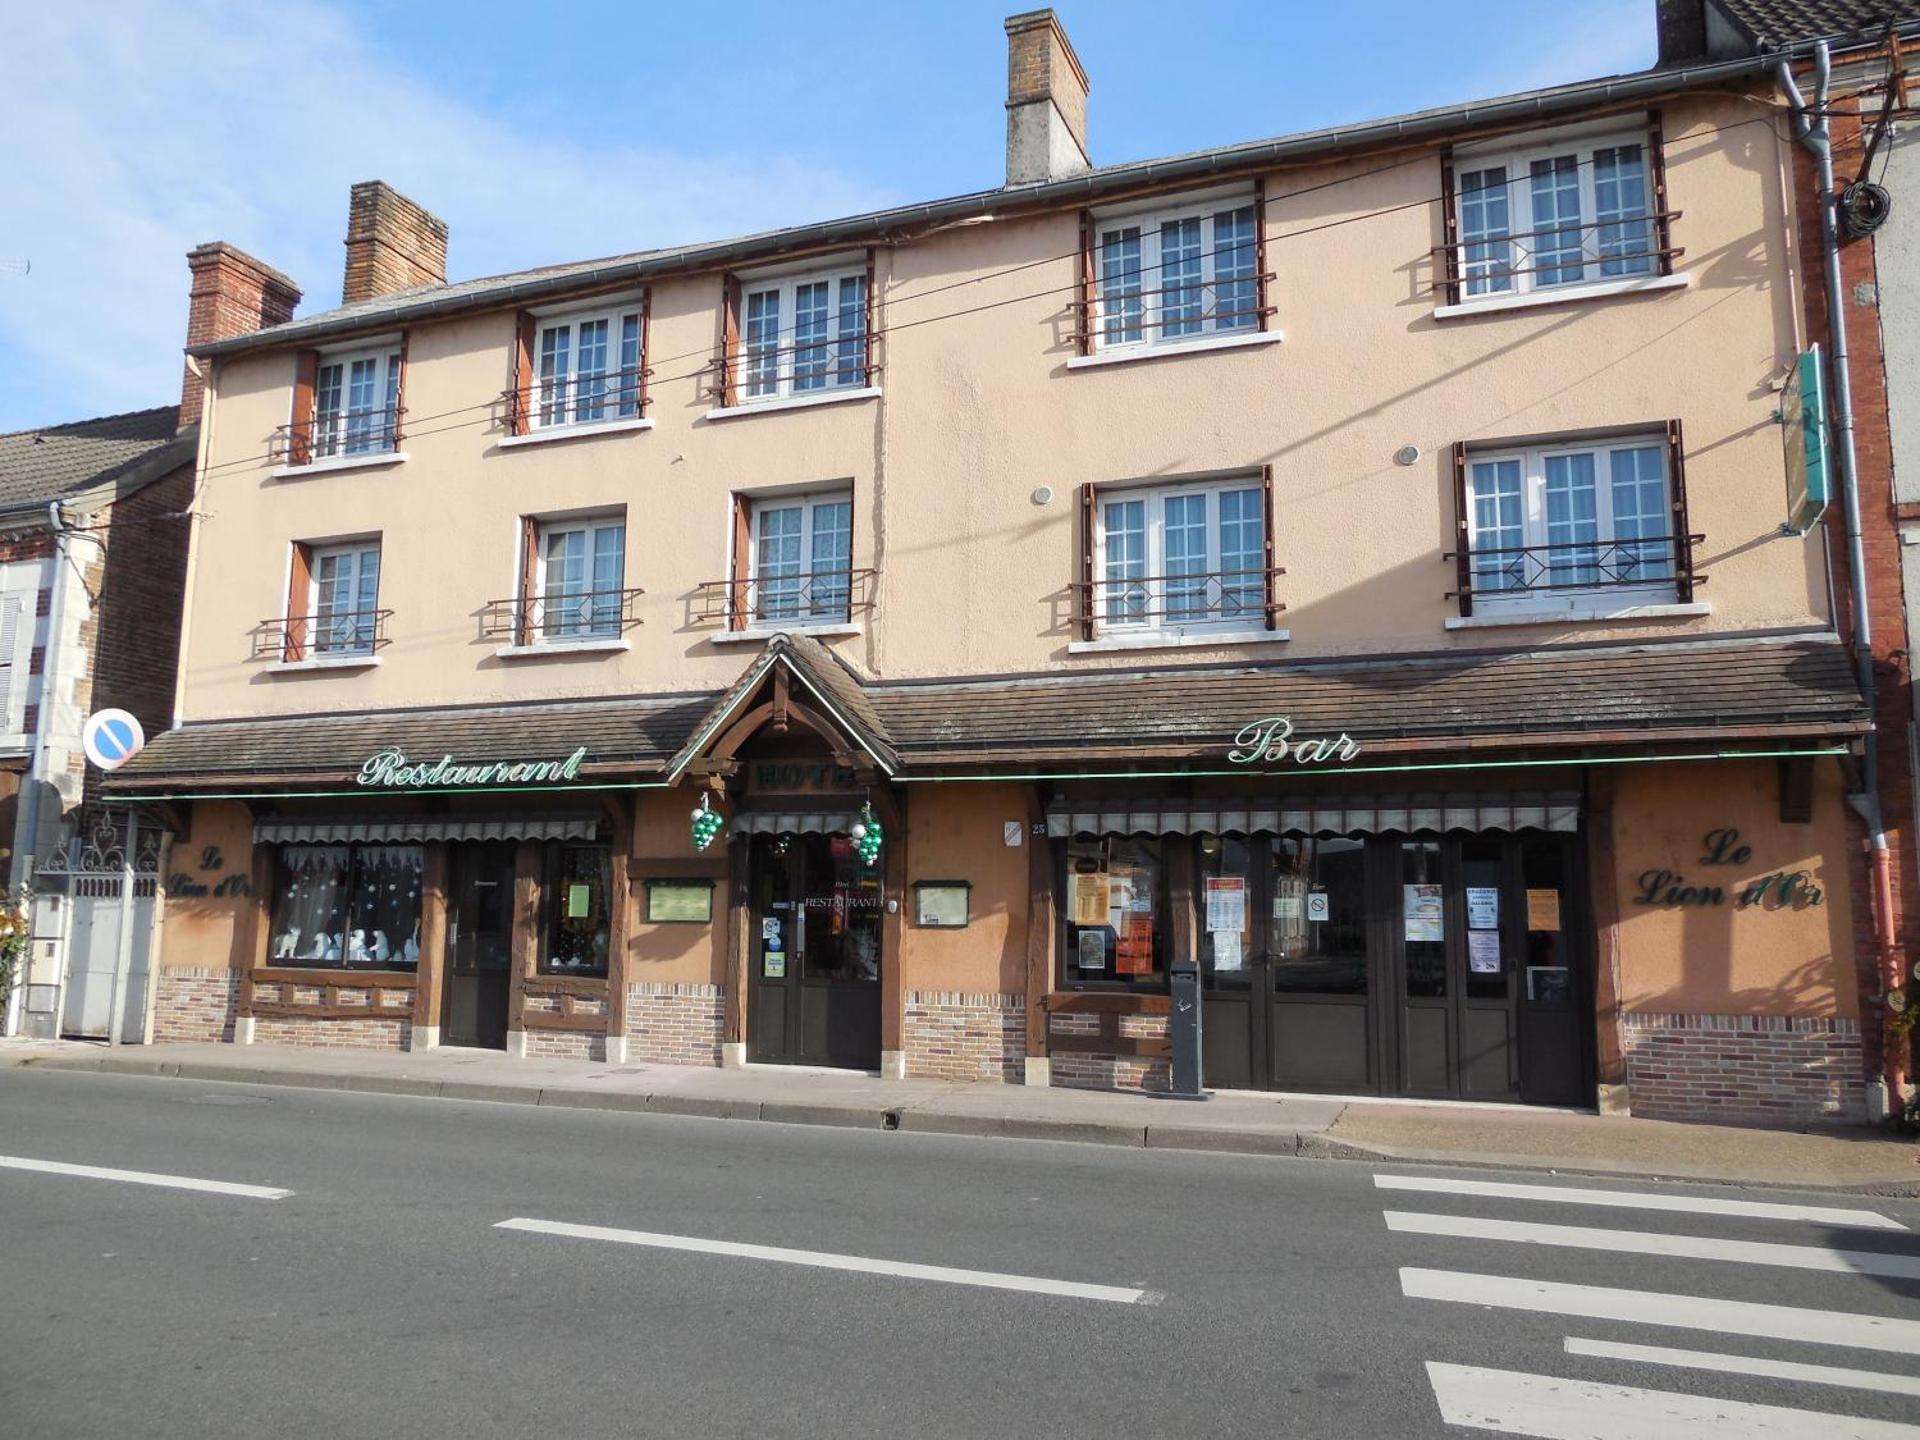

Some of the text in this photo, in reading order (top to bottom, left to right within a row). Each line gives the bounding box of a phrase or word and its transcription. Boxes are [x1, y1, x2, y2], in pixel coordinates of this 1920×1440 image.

[1228, 716, 1361, 764] Bar
[356, 746, 588, 787] Restaurant
[1699, 828, 1752, 866] Le
[1635, 869, 1724, 906] Lion
